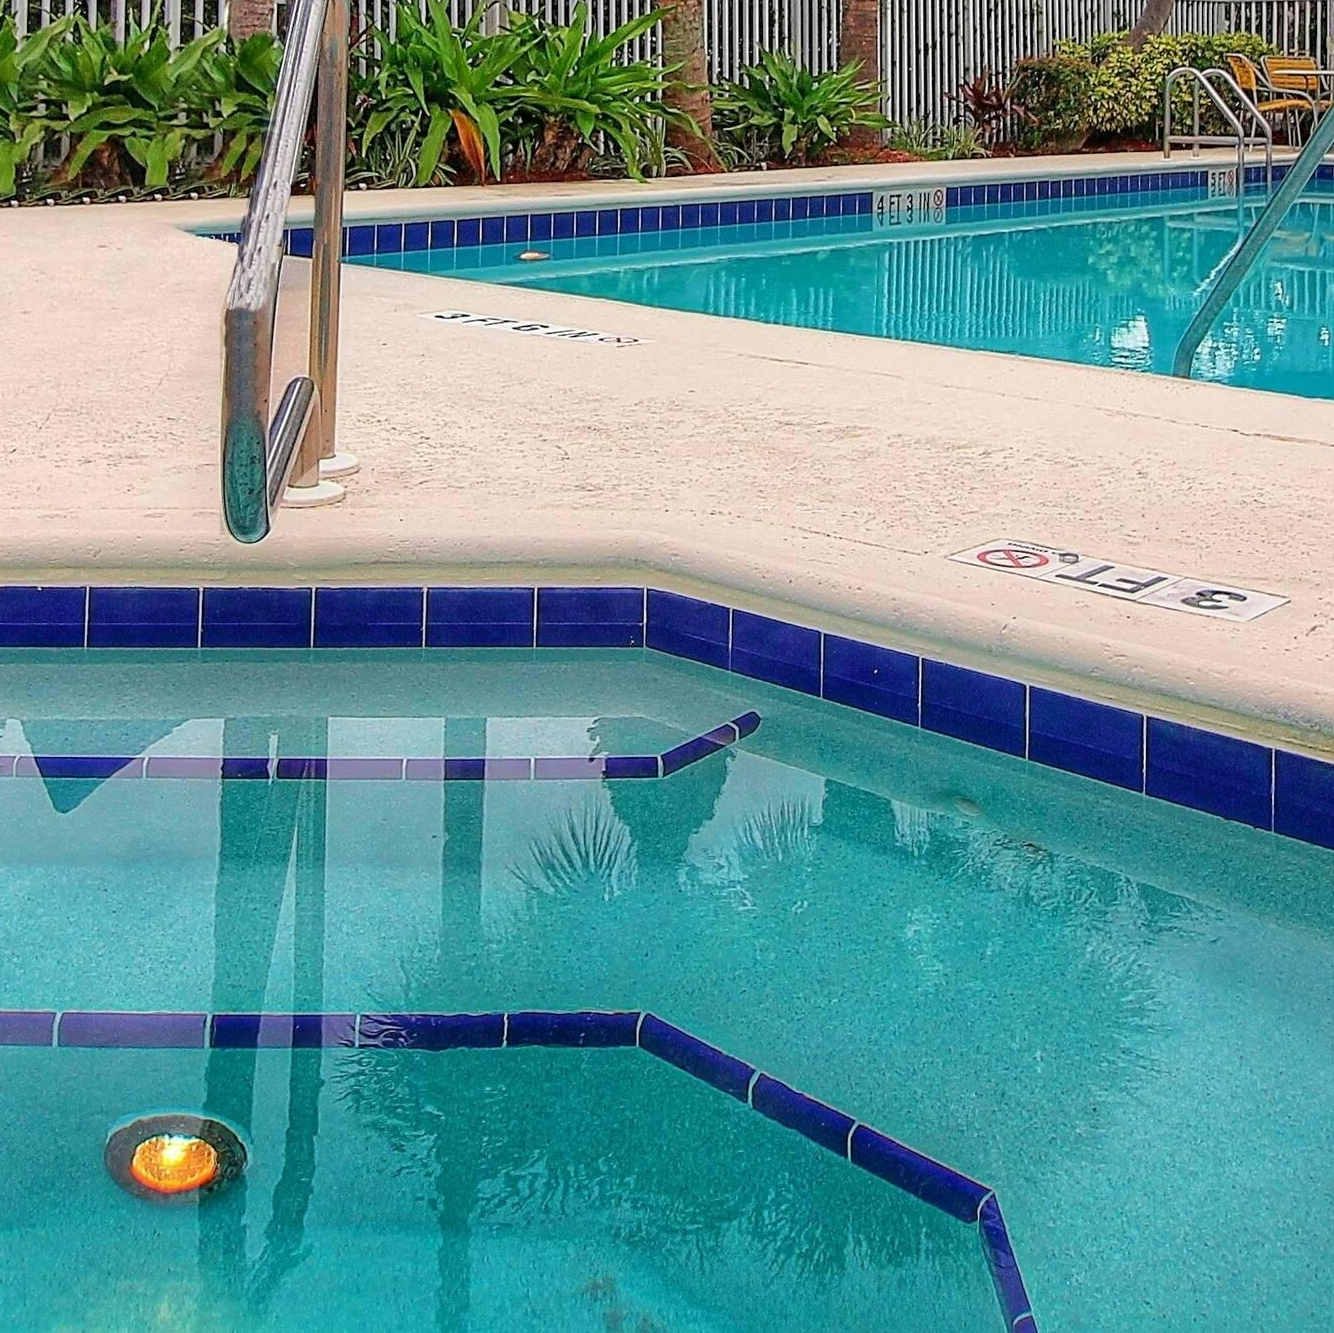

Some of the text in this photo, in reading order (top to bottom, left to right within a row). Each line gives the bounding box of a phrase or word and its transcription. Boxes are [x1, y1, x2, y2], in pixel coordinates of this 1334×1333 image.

[877, 193, 929, 212] 4 FT 3 IN
[1055, 565, 1247, 609] 3 FT
